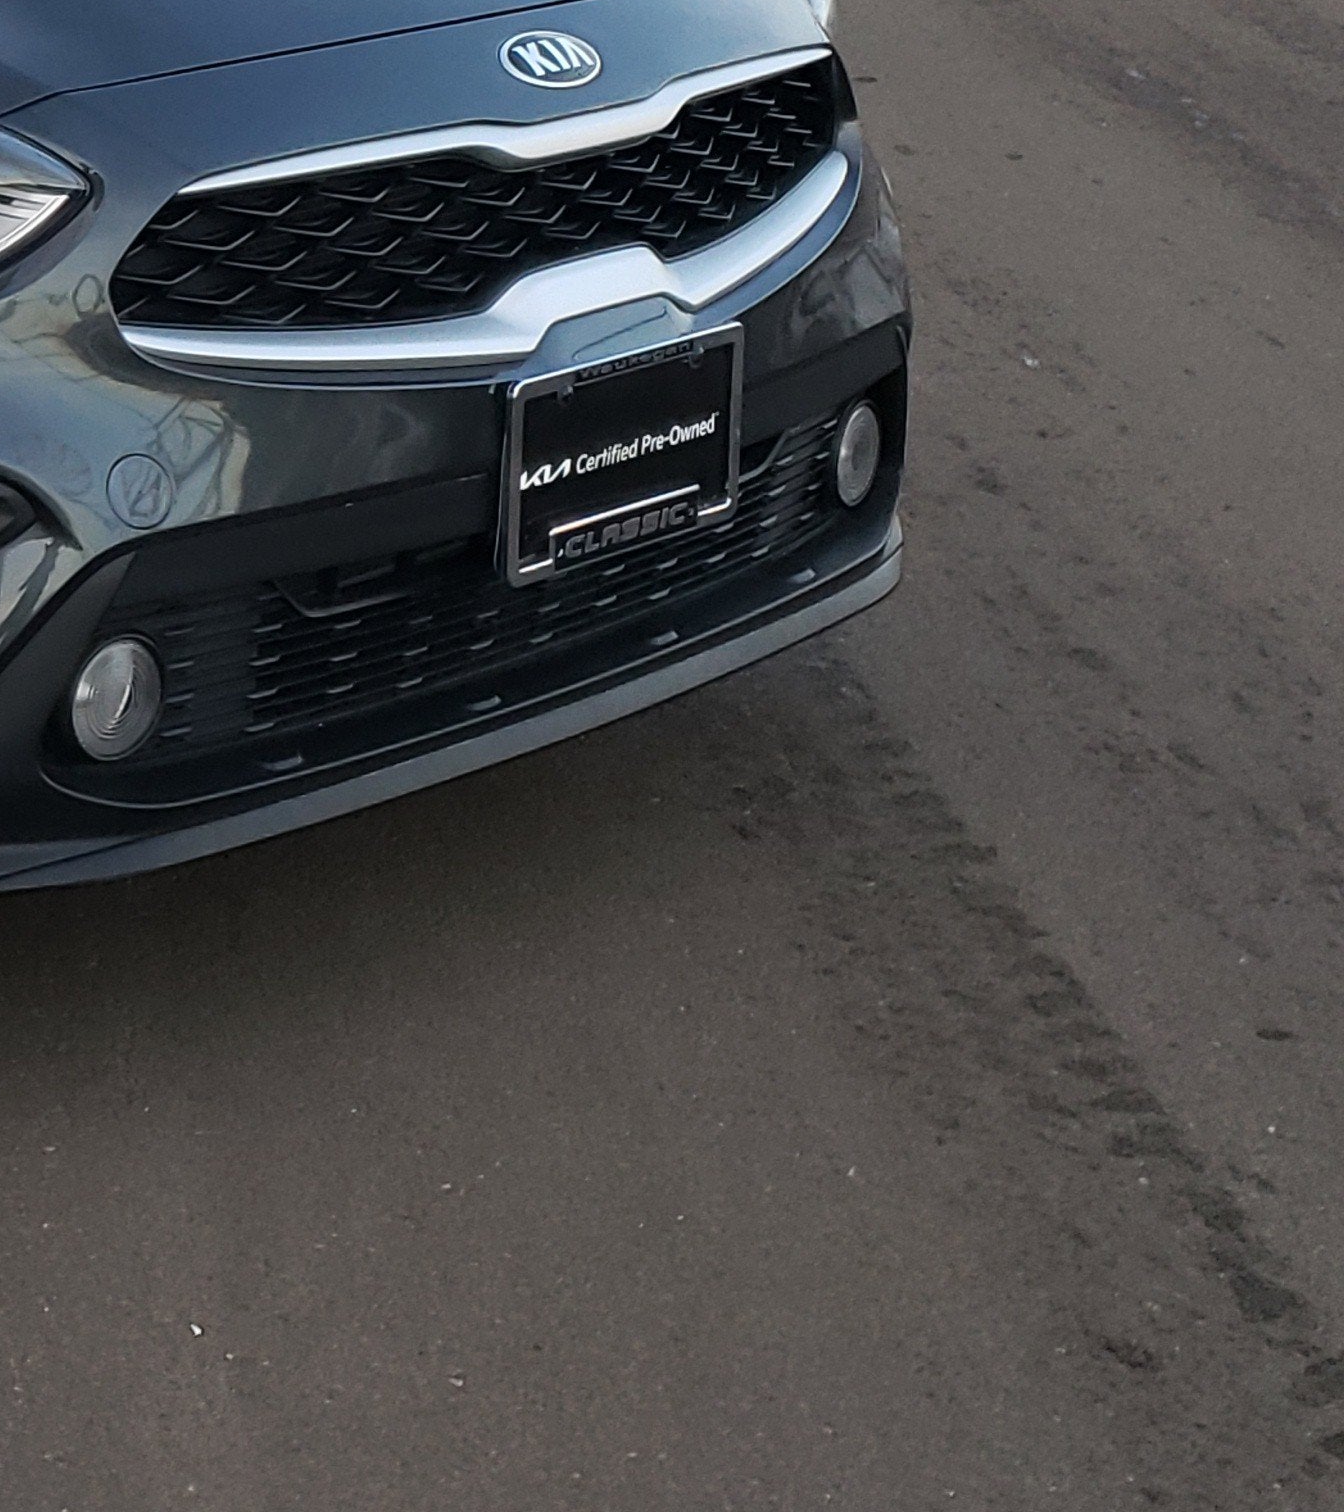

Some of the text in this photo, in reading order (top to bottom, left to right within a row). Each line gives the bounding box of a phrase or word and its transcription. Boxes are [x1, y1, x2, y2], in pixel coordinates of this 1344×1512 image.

[510, 35, 596, 78] KIA
[520, 458, 572, 491] KIA
[575, 438, 638, 475] Certified
[564, 501, 689, 559] CLASSIC
